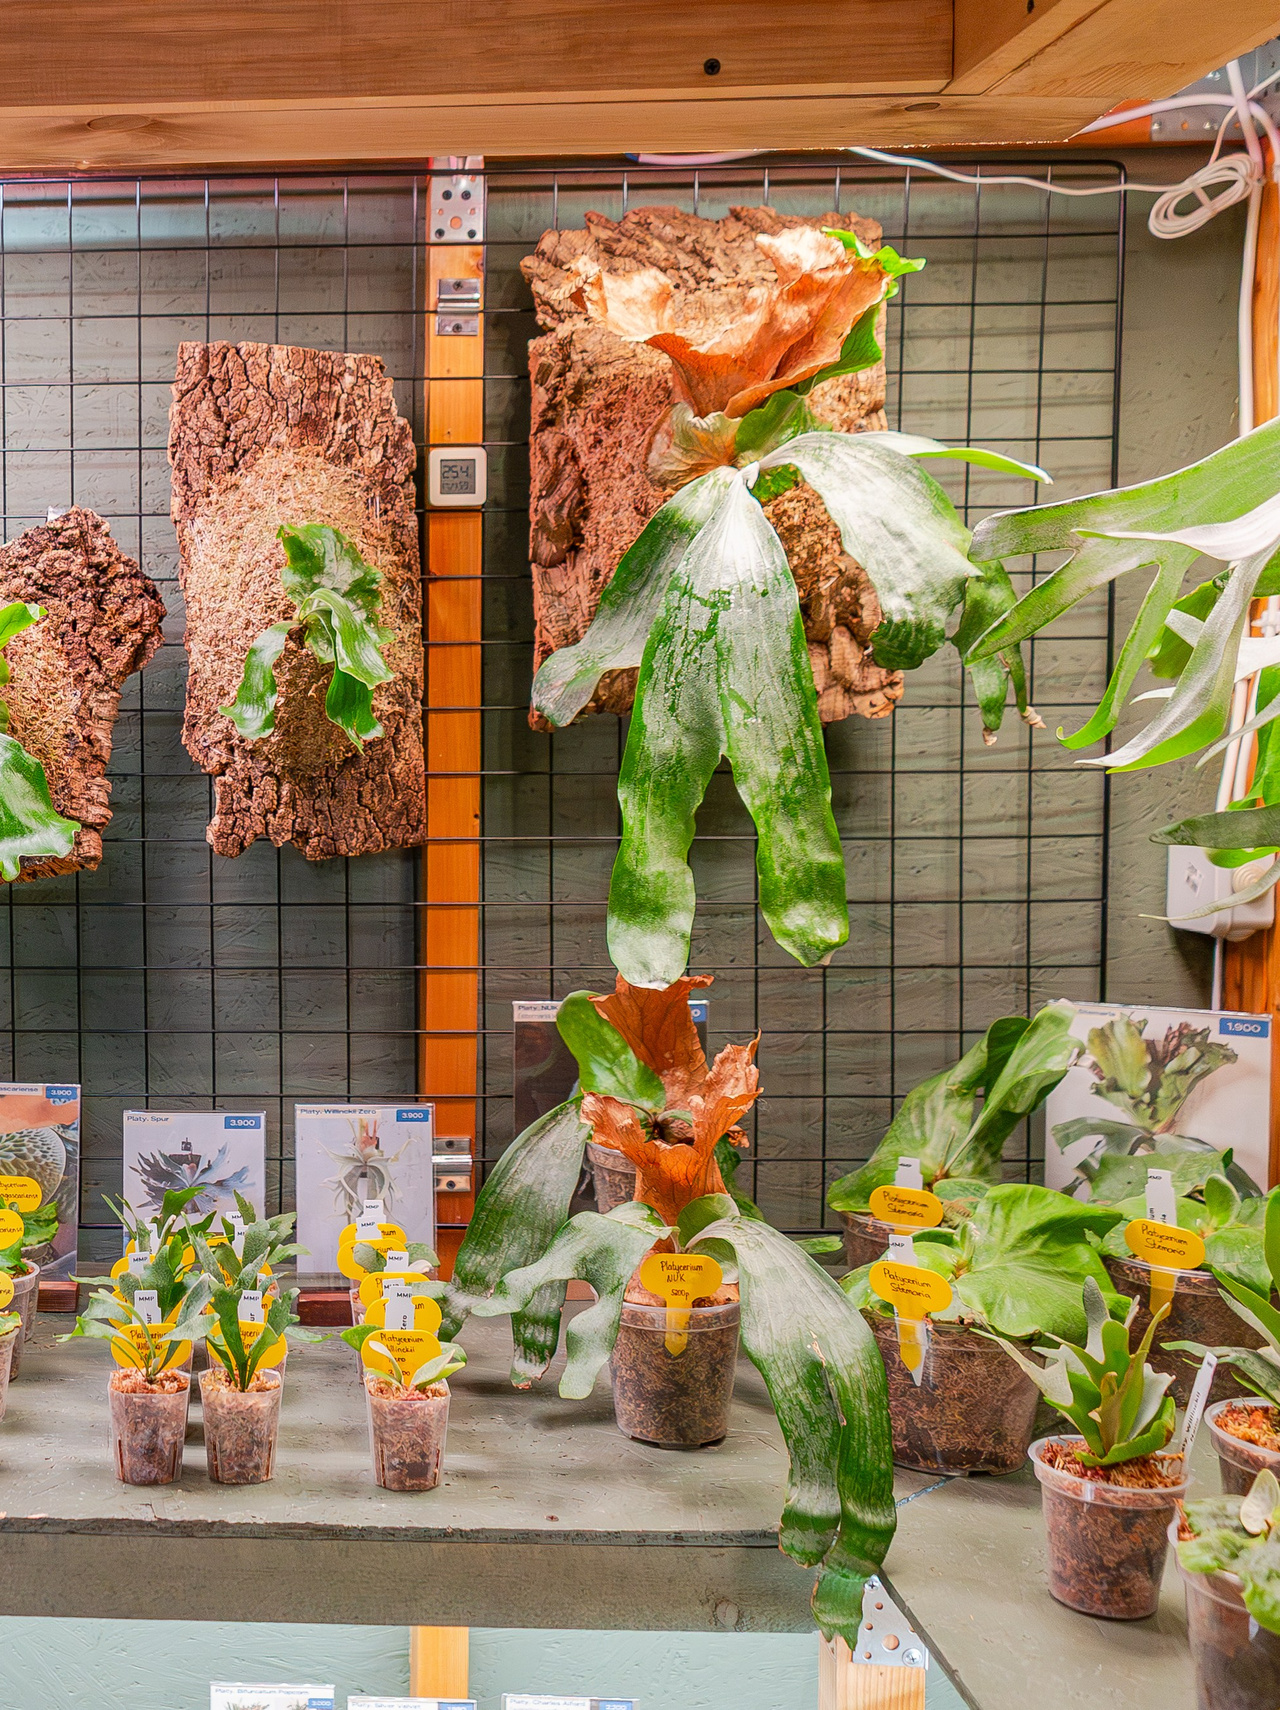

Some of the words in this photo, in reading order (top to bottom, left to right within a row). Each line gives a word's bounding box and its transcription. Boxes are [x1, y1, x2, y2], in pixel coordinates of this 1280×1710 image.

[1226, 1022, 1262, 1033] 1.900
[660, 1260, 703, 1274] Platycerium
[666, 1273, 686, 1283] NUK
[380, 1332, 425, 1345] Platycerium
